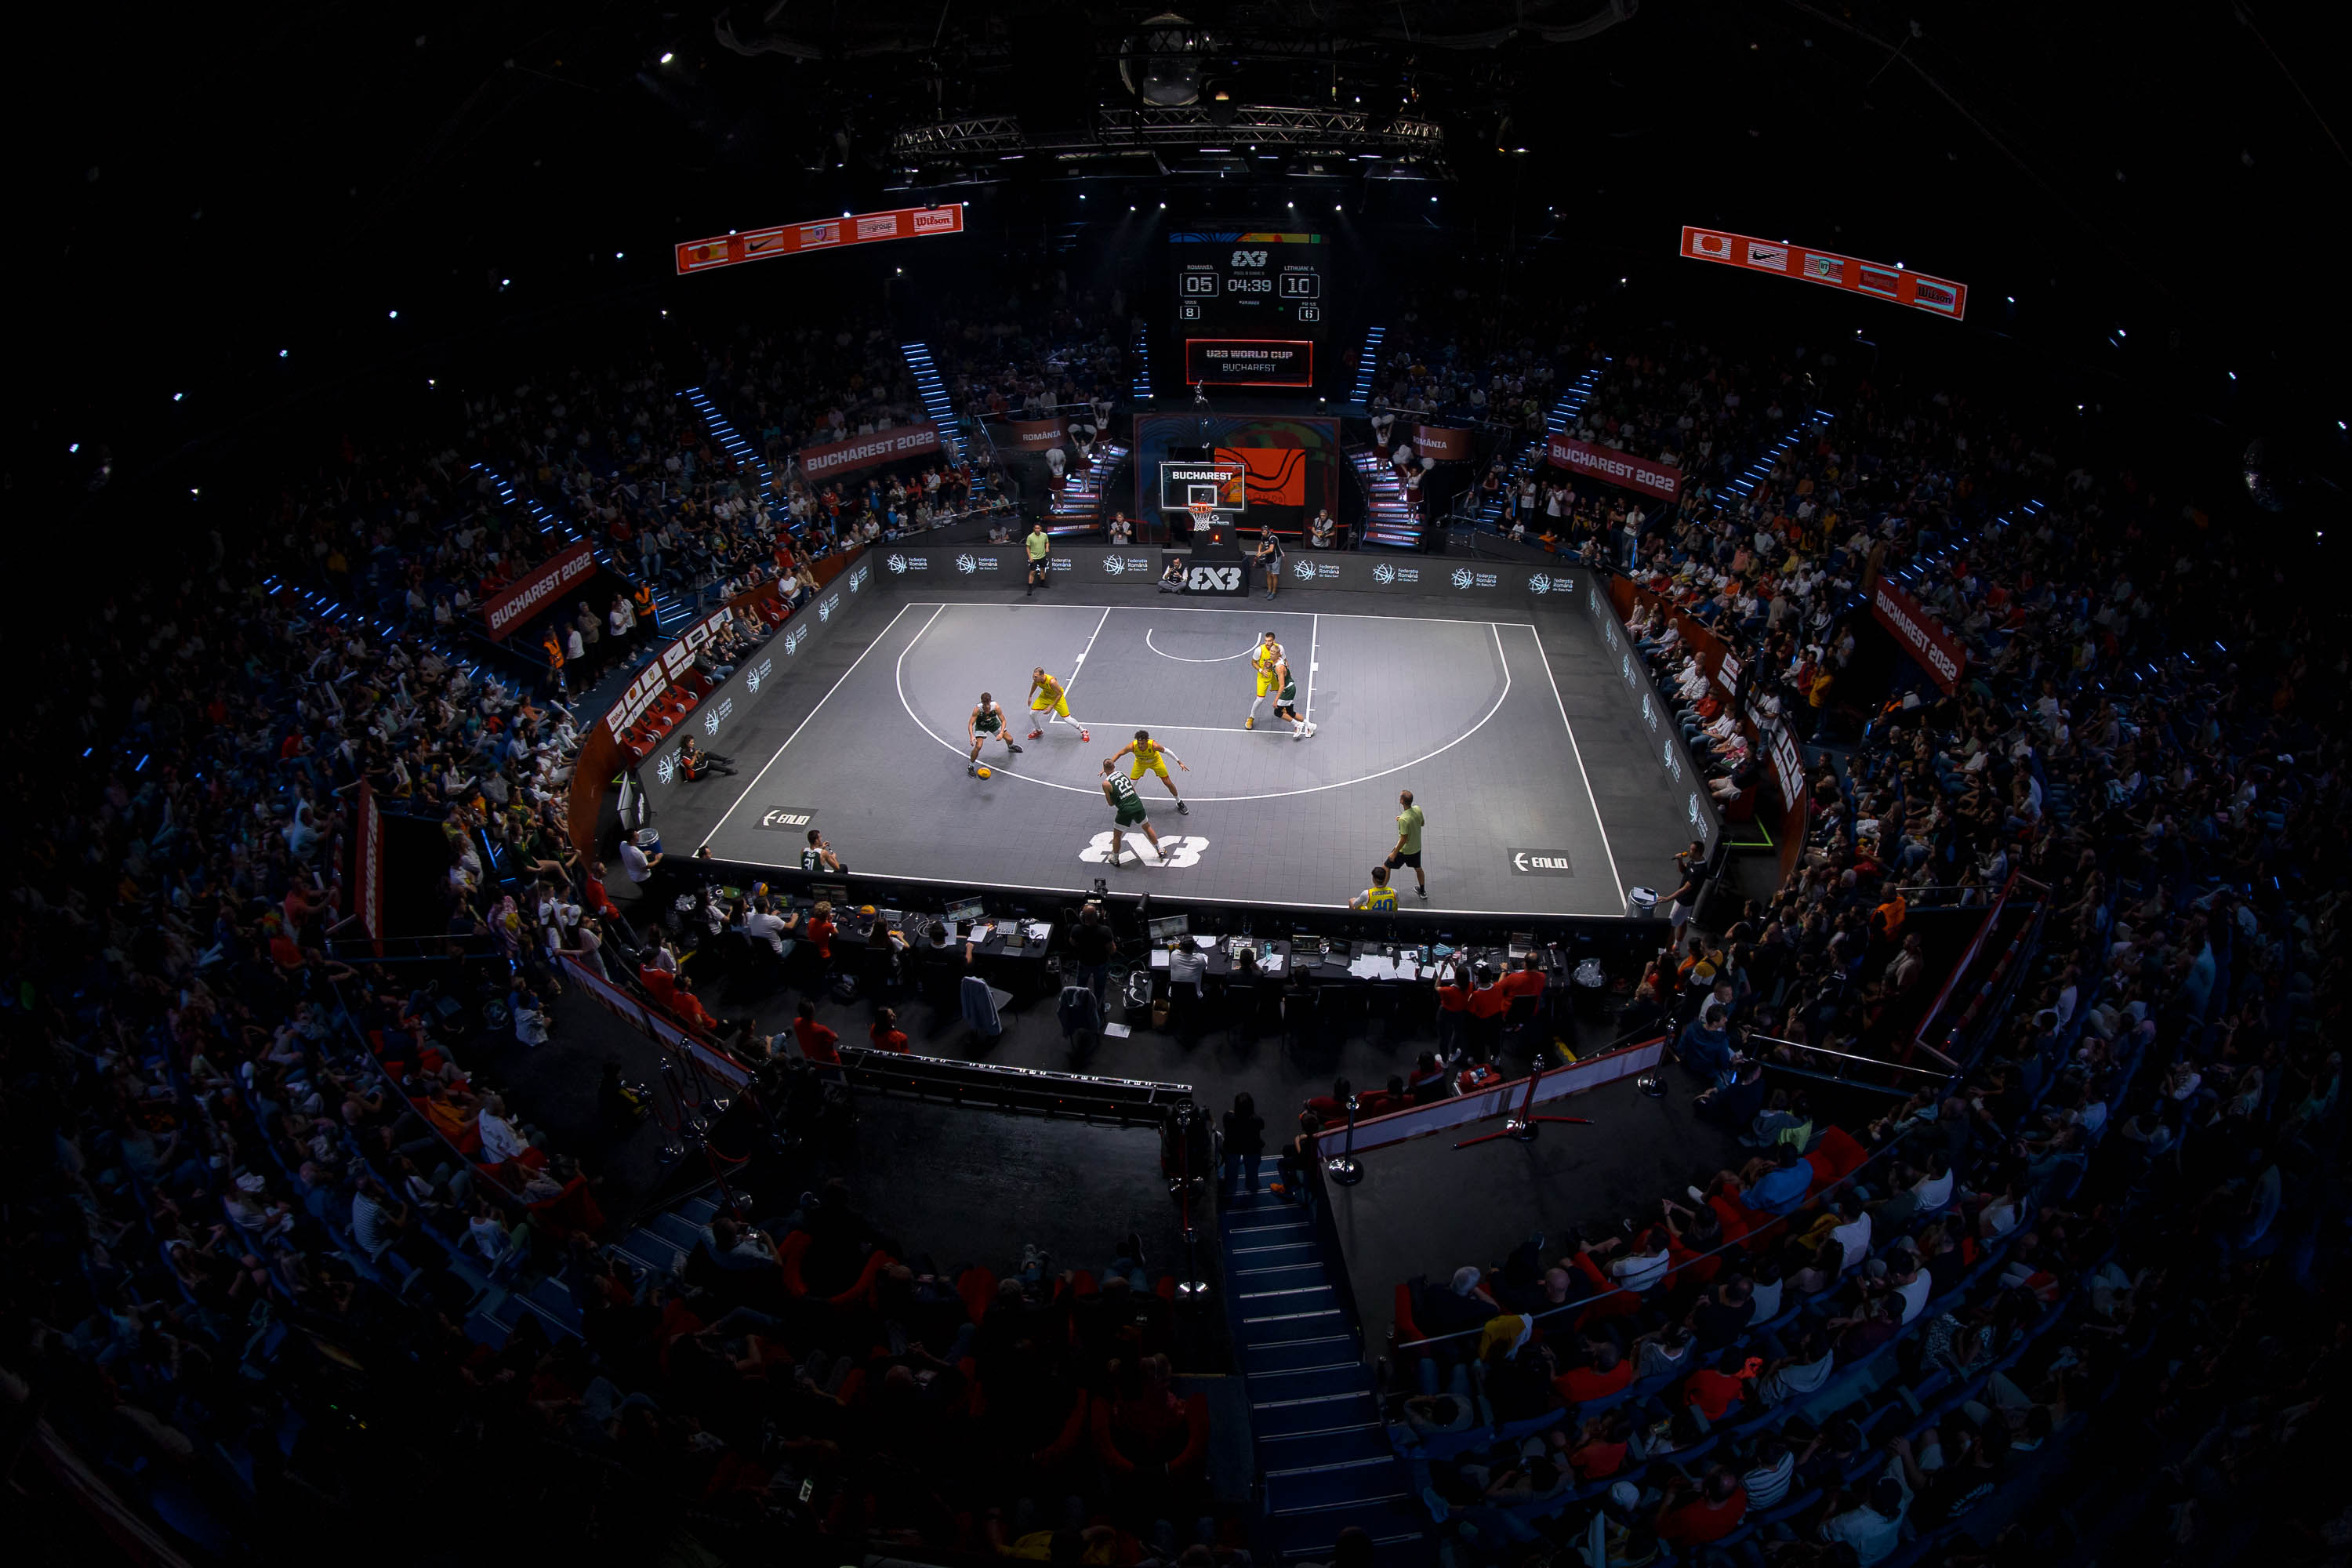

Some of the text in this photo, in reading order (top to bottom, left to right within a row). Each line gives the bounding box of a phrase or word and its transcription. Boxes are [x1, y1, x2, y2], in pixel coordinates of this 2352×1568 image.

[916, 216, 949, 227] Wilson
[1186, 277, 1213, 292] 05
[1228, 279, 1272, 292] 04:39
[1917, 286, 1951, 305] Wilson
[1186, 308, 1194, 317] 8
[1206, 350, 1294, 359] U23 WORLD CUP
[1222, 363, 1276, 372] BUCHAREST
[807, 431, 935, 471] BUCHAREST 2022
[1552, 445, 1675, 492] BUCHAREST 2022
[1172, 470, 1233, 481] BUCHAREST
[490, 551, 592, 630] BUCHAREST 2022
[1876, 590, 1958, 682] BUCHAREST 2022
[1114, 776, 1133, 793] 22
[804, 858, 815, 871] 31
[1372, 898, 1393, 910] 40
